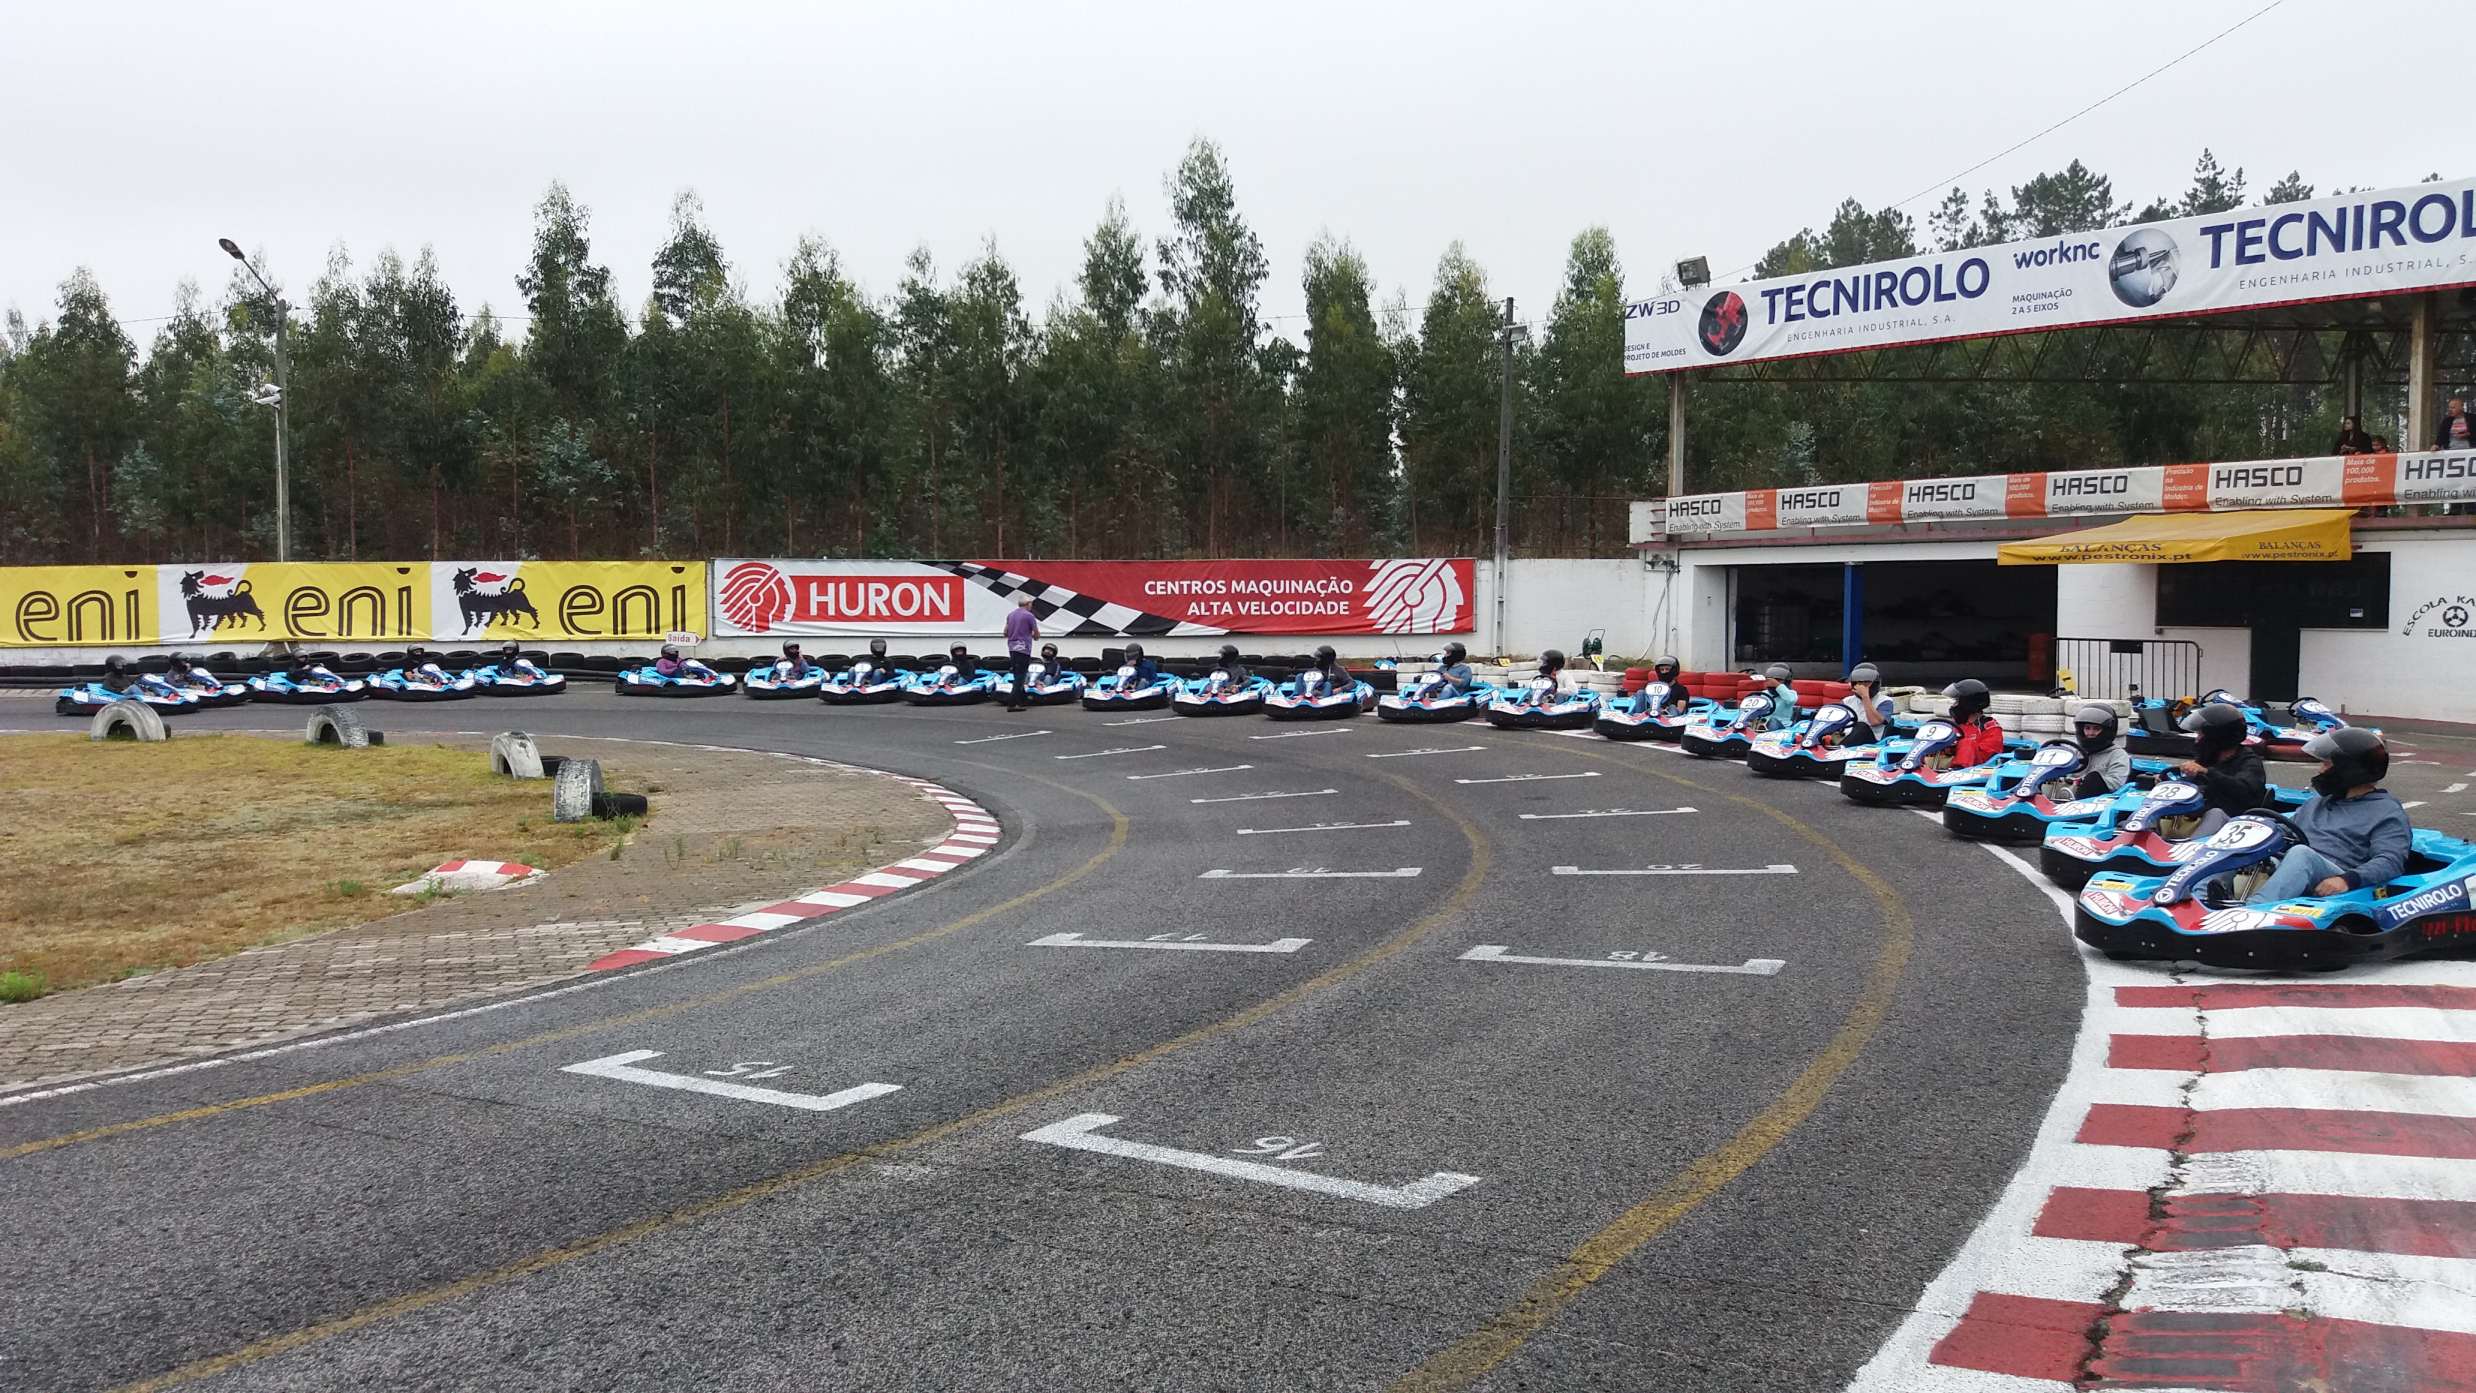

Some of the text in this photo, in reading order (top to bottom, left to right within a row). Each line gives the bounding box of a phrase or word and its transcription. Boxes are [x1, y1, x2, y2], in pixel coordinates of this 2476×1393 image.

[2013, 239, 2101, 270] worknc
[2239, 270, 2337, 290] ENGENHARIA
[2345, 258, 2450, 277] INDUSTRIAL,
[1760, 257, 1990, 325] TECNIROLO
[2011, 288, 2073, 303] MAQUINAÇÃO
[2011, 302, 2060, 315] 2 A 5 EIXOS
[1787, 326, 1854, 343] ENGENHARIA
[1858, 318, 1928, 334] INDUSTRIAL,
[1661, 348, 1687, 357] MOLDES
[2052, 475, 2129, 497] HASCO
[2215, 466, 2303, 489] HASCO
[1781, 490, 1841, 511] HASCO
[1908, 483, 1976, 503] HASCO
[2215, 497, 2262, 508] Enabling
[2265, 495, 2288, 505] with
[2403, 487, 2459, 500] Enabling
[1669, 499, 1722, 518] HASCO
[1907, 510, 1944, 520] Enabling
[1945, 508, 1964, 518] with
[2052, 503, 2093, 514] Enabling
[2094, 502, 2114, 512] with
[2258, 541, 2321, 551] BALANÇAS
[2032, 552, 2193, 562] www.pestronix.pt
[1144, 575, 1353, 598] CENTROS MAQUINAÇÃO
[15, 570, 141, 642] eni
[284, 567, 412, 637] eni
[558, 566, 687, 635] eni
[809, 582, 950, 617] HURON
[1187, 601, 1349, 616] ALTA VELOCIDADE
[2402, 596, 2448, 637] ESCOLA
[1653, 685, 1663, 694] 10
[1927, 726, 1937, 738] 9
[2154, 786, 2181, 798] 28
[2216, 824, 2253, 845] 35
[2386, 884, 2463, 921] TECNIROLO
